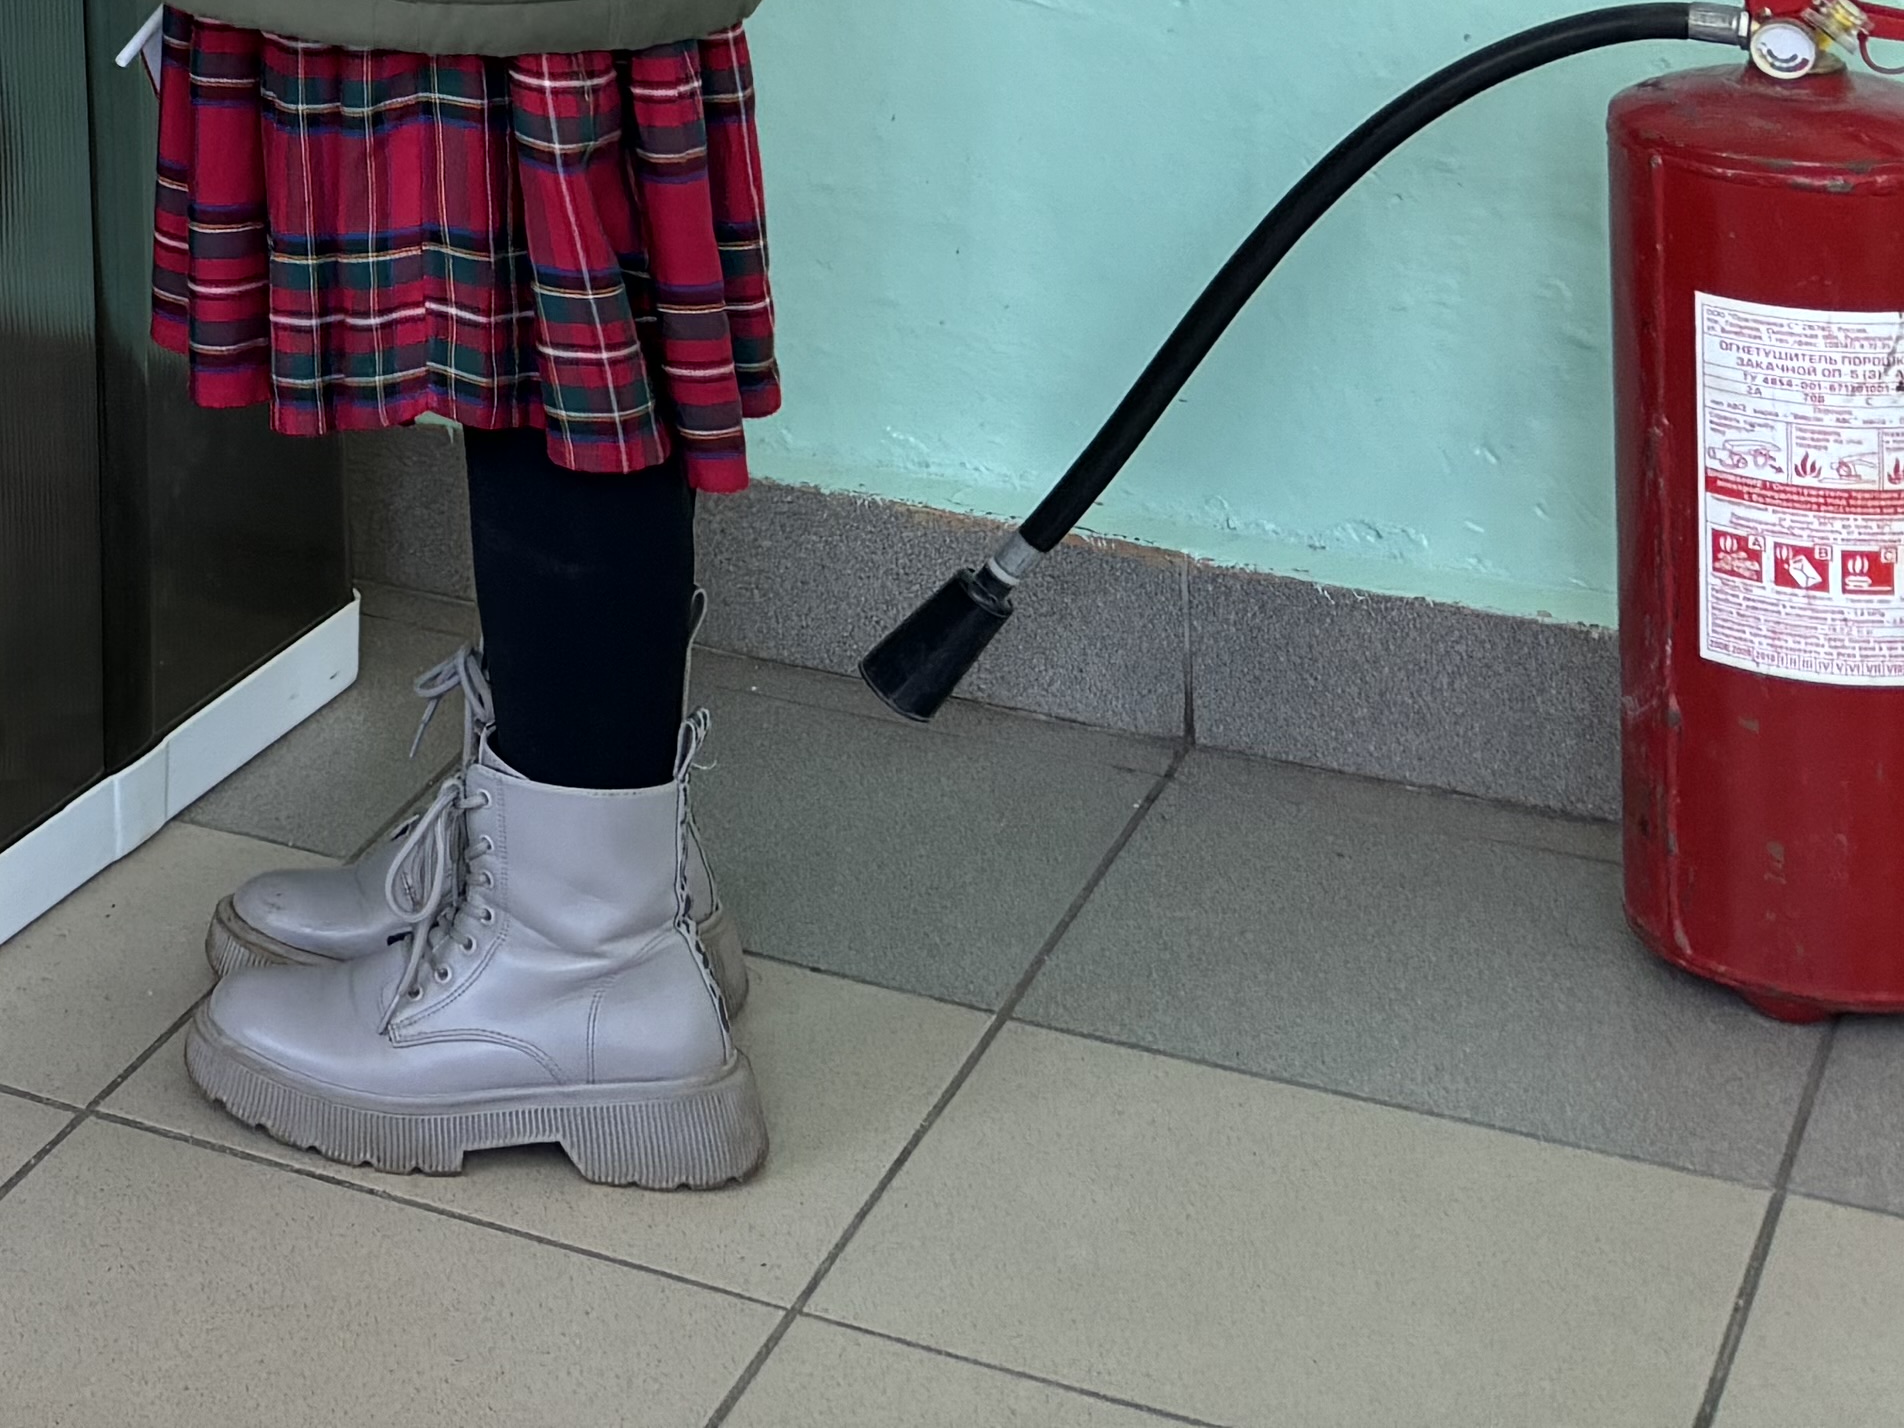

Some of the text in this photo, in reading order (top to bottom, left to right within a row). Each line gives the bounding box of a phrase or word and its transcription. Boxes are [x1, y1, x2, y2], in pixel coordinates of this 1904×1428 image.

[1719, 340, 1837, 366] ОГНЕТУШИТЕЛЬ
[1736, 357, 1818, 377] ЗАКАЧНОЙ
[1819, 548, 1829, 559] B
